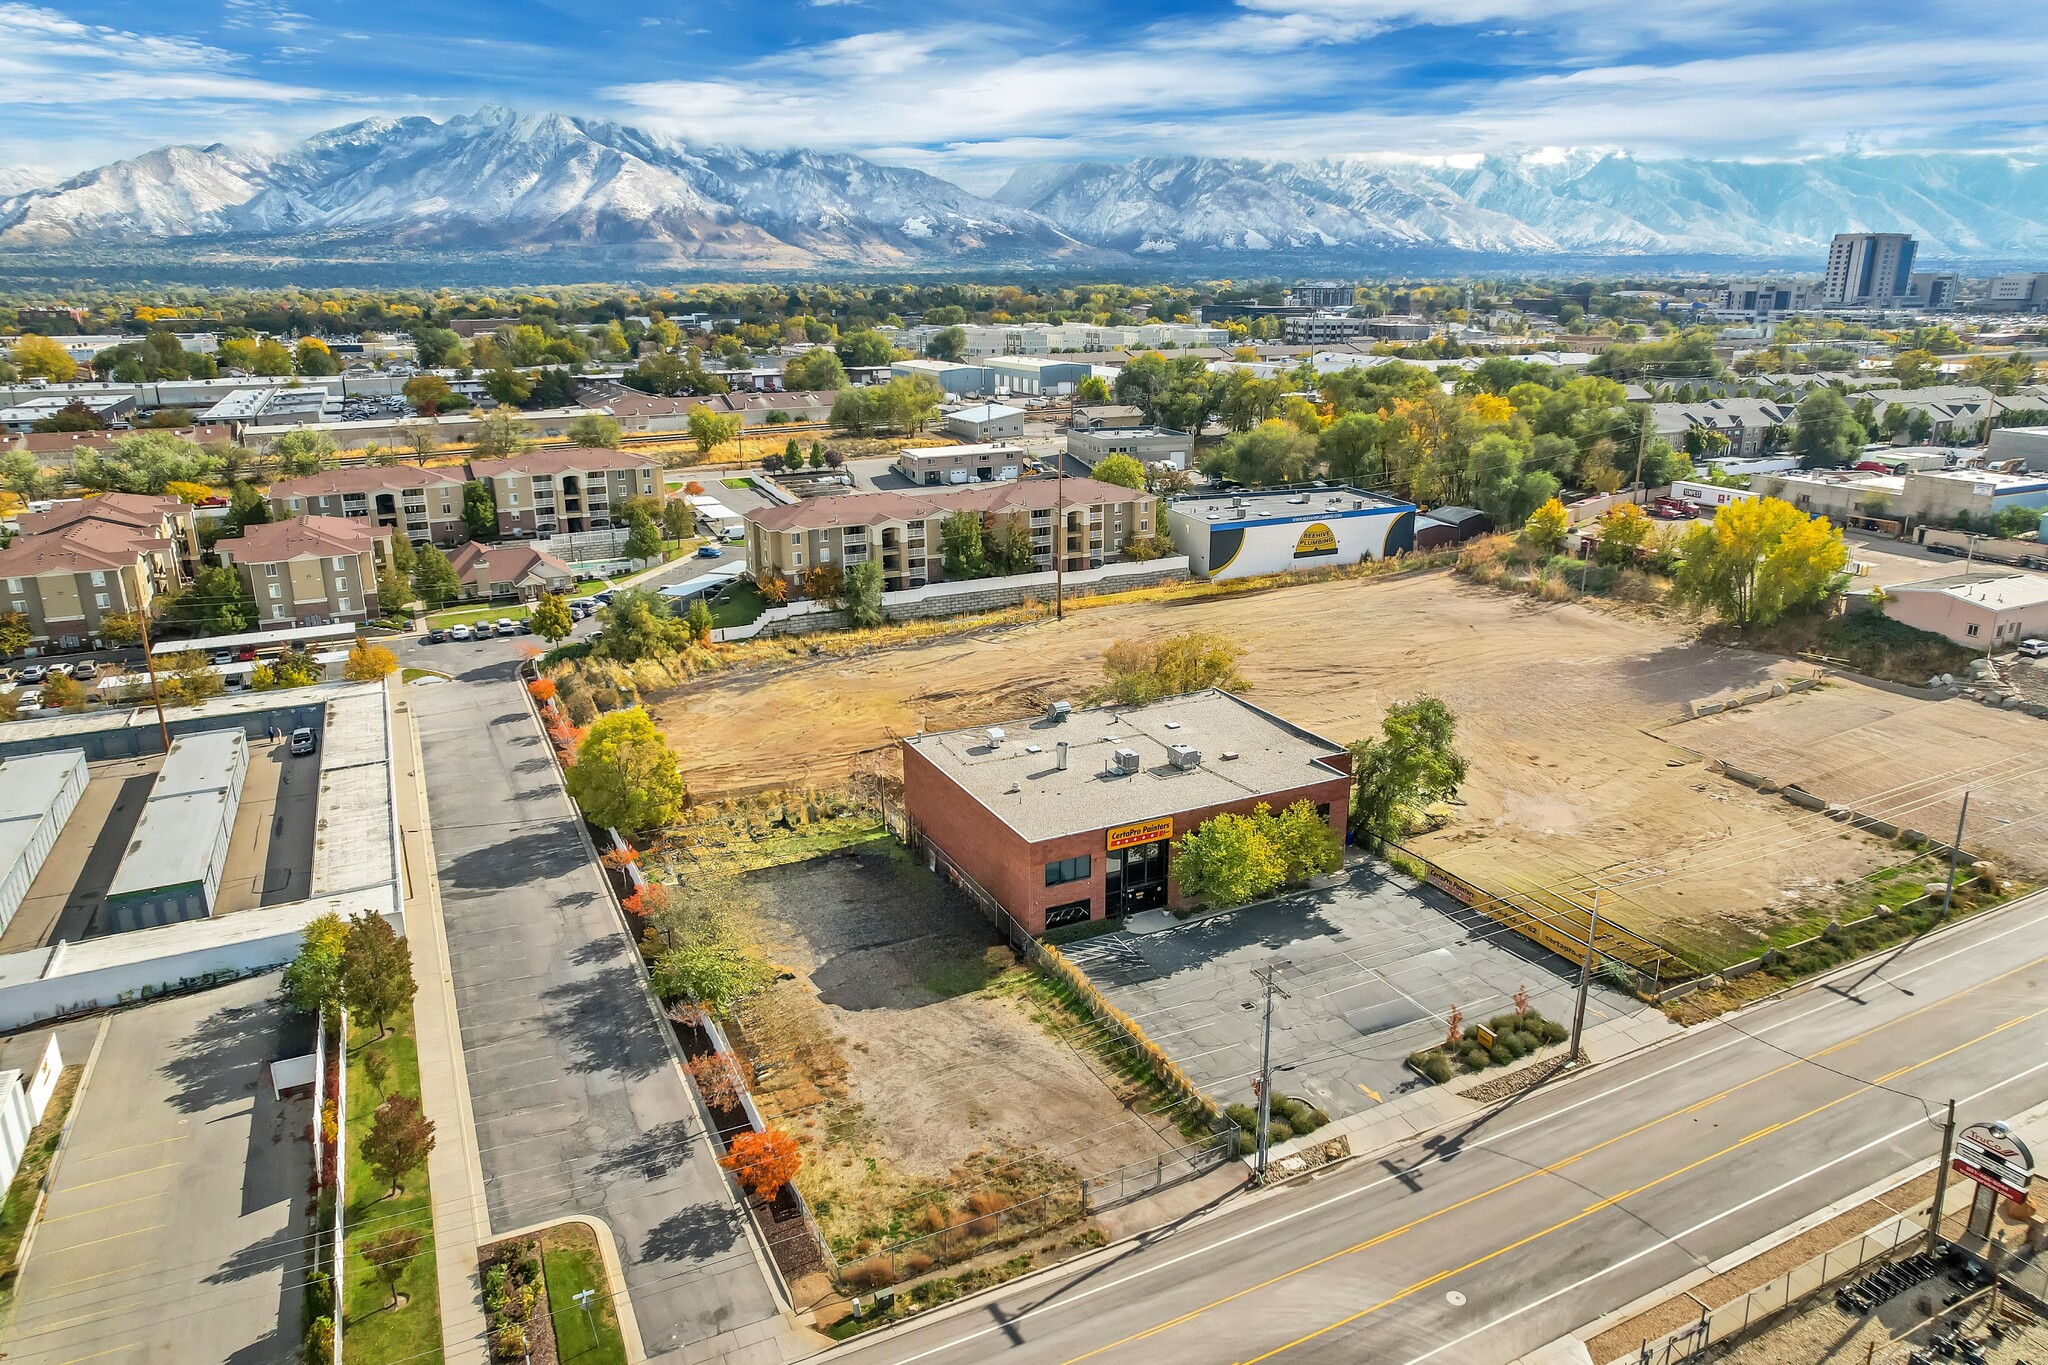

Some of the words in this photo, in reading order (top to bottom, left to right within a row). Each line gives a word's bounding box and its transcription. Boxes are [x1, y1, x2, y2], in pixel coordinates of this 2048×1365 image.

[1112, 829, 1141, 839] CertaPro
[1143, 823, 1170, 833] Painters
[1430, 869, 1453, 886] CertaPro
[1453, 881, 1475, 898] Painters
[1545, 936, 1594, 965] certapro.co
[1970, 1130, 2002, 1151] TruCo
